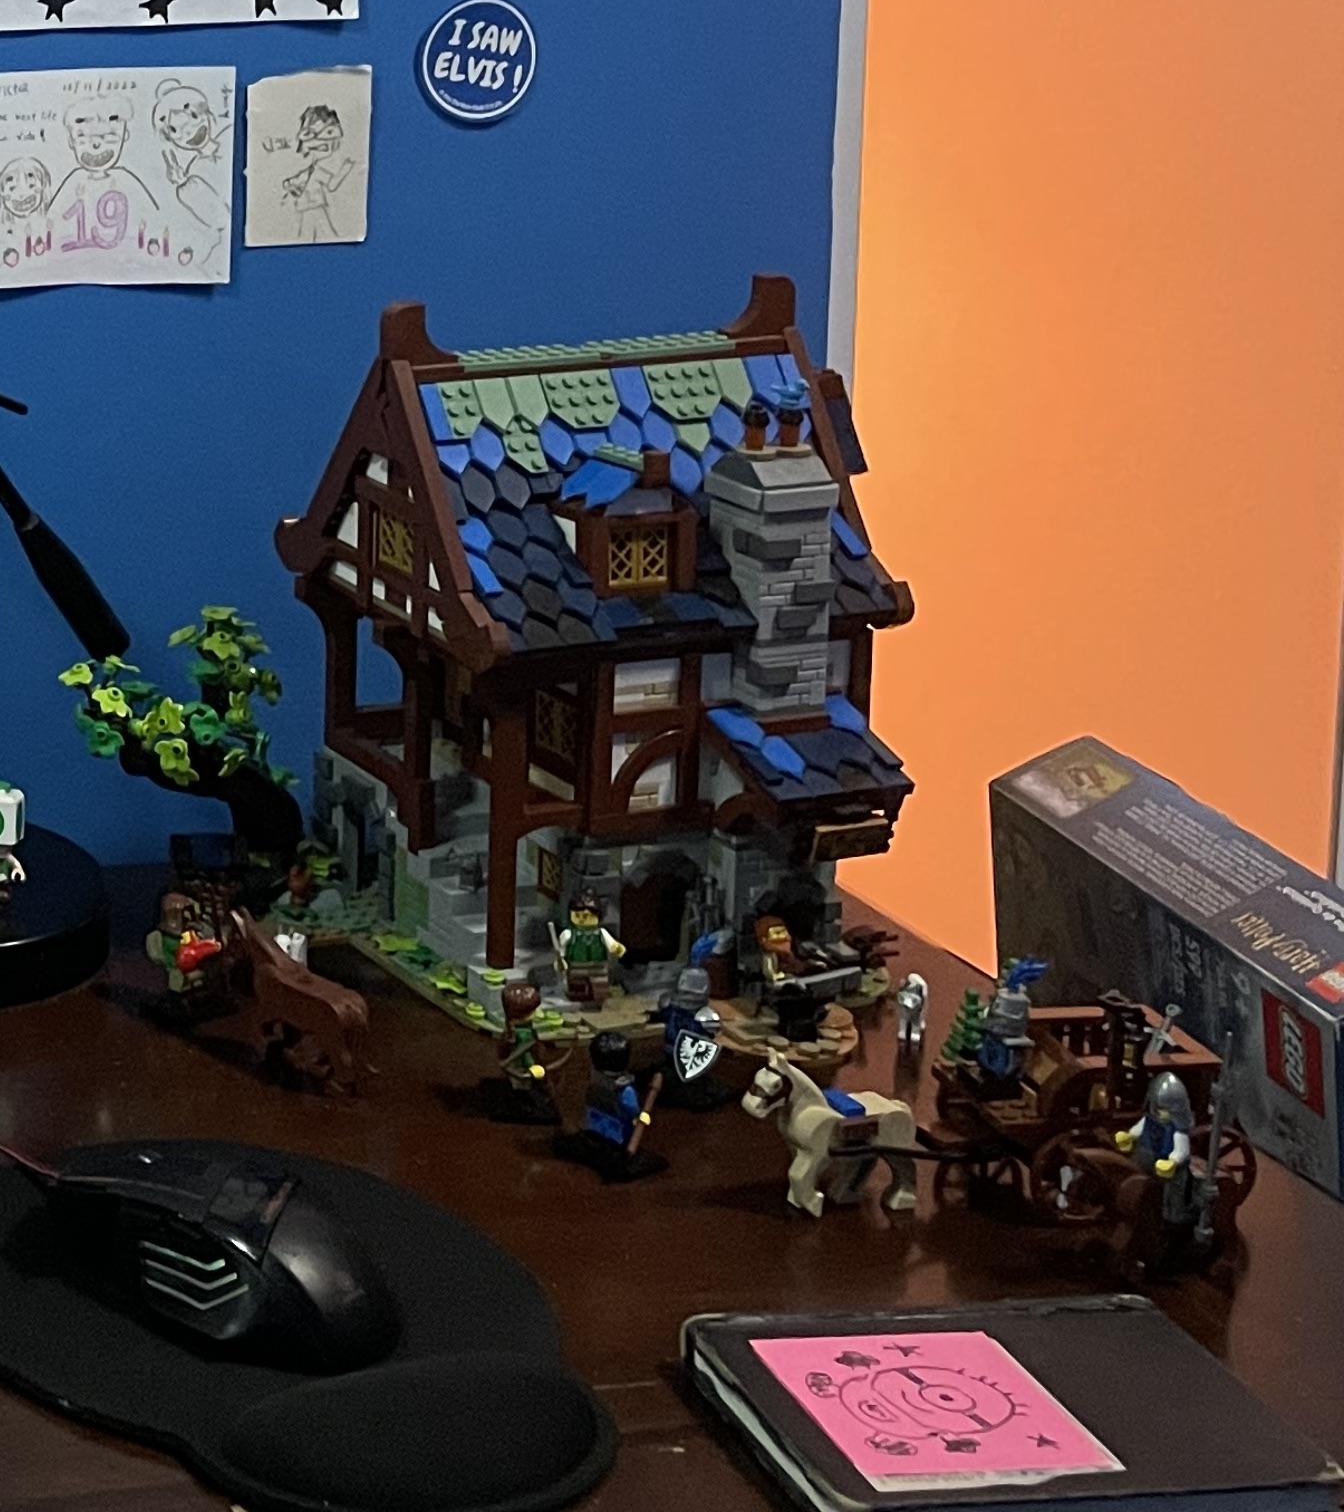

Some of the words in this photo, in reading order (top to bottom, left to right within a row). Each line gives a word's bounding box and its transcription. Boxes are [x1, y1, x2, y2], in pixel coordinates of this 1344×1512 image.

[448, 18, 467, 45] I
[467, 21, 523, 56] SAW
[60, 190, 129, 252] 19
[1278, 1003, 1307, 1090] LEGO
